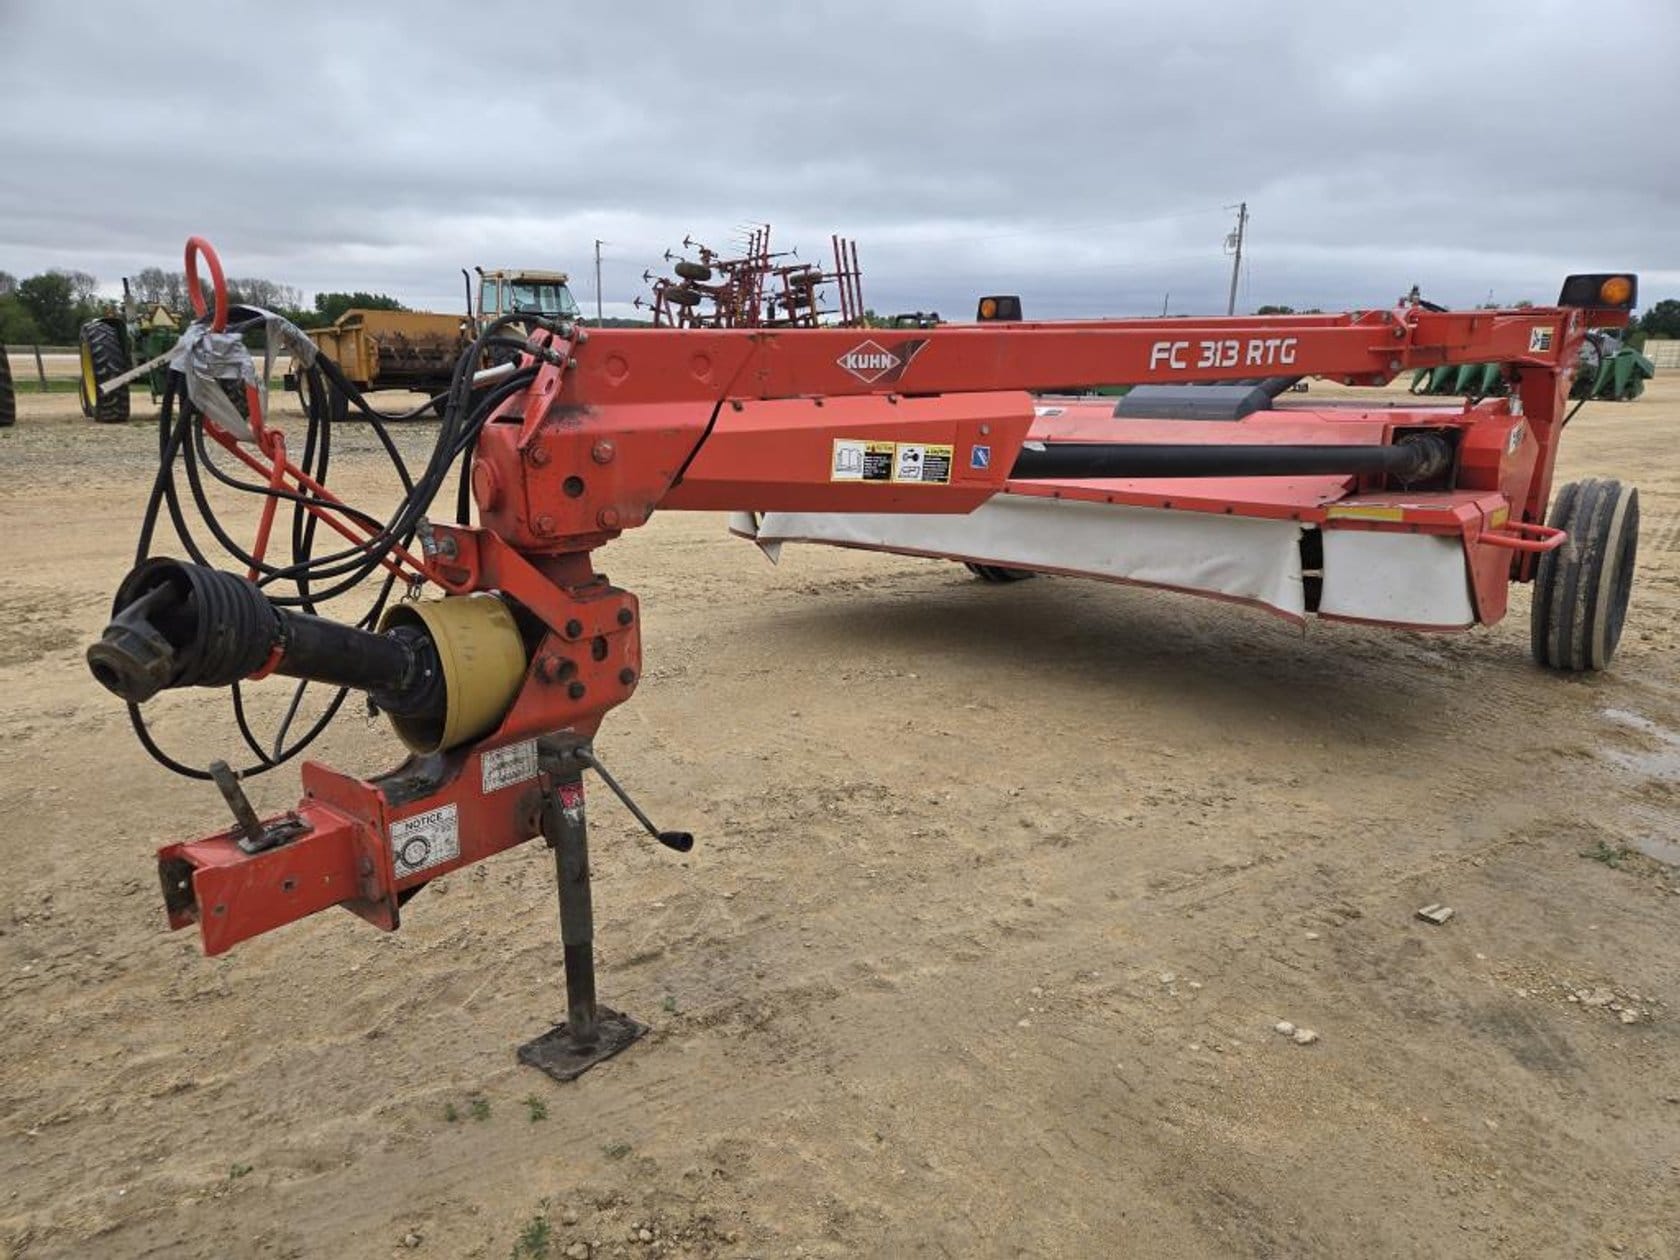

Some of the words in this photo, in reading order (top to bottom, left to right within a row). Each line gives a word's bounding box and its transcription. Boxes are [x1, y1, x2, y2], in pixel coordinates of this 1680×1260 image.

[847, 354, 891, 369] KUHN
[1150, 341, 1189, 370] FC
[1197, 340, 1240, 367] 313
[1246, 338, 1297, 365] RTG
[405, 812, 442, 830] NOTICE
